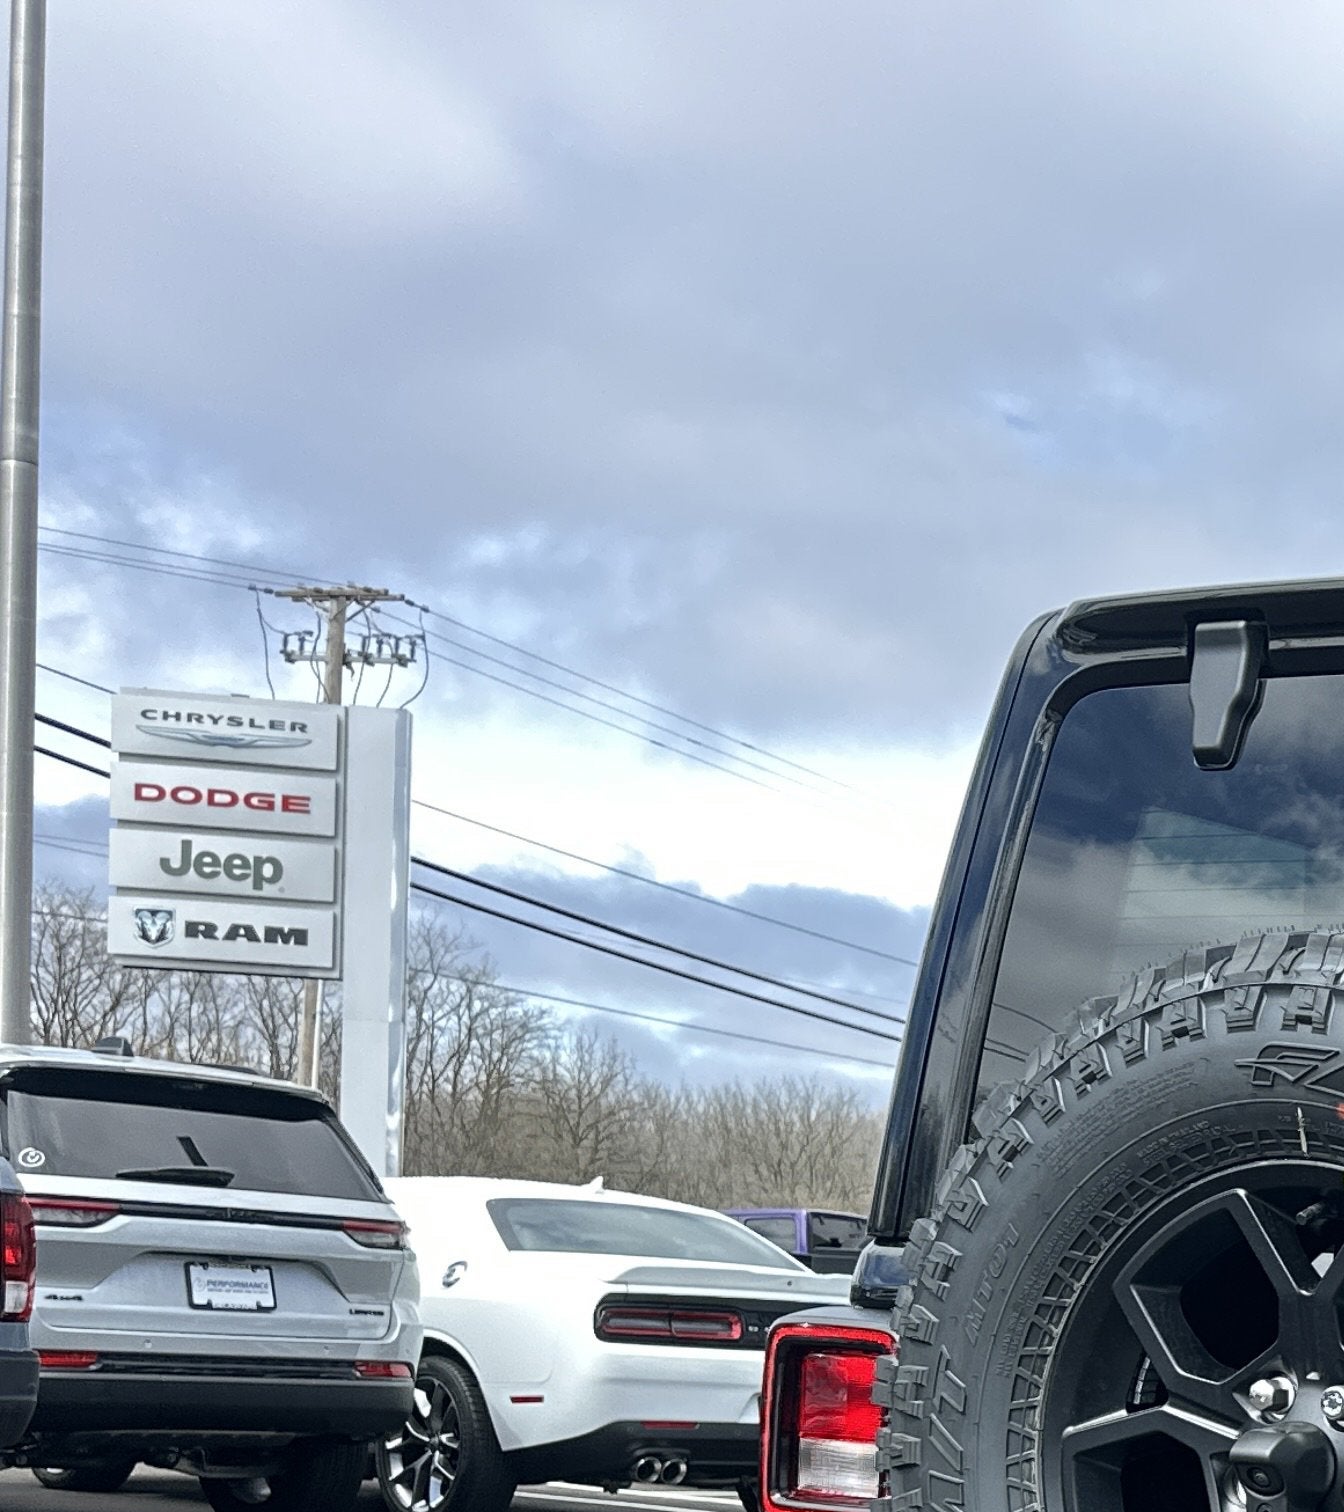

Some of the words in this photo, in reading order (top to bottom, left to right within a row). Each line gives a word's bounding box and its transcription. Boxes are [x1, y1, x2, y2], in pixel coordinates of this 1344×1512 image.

[140, 708, 308, 734] CHRYSLER
[134, 782, 311, 814] DODGE
[159, 839, 284, 891] Jeep
[184, 919, 309, 946] RAM
